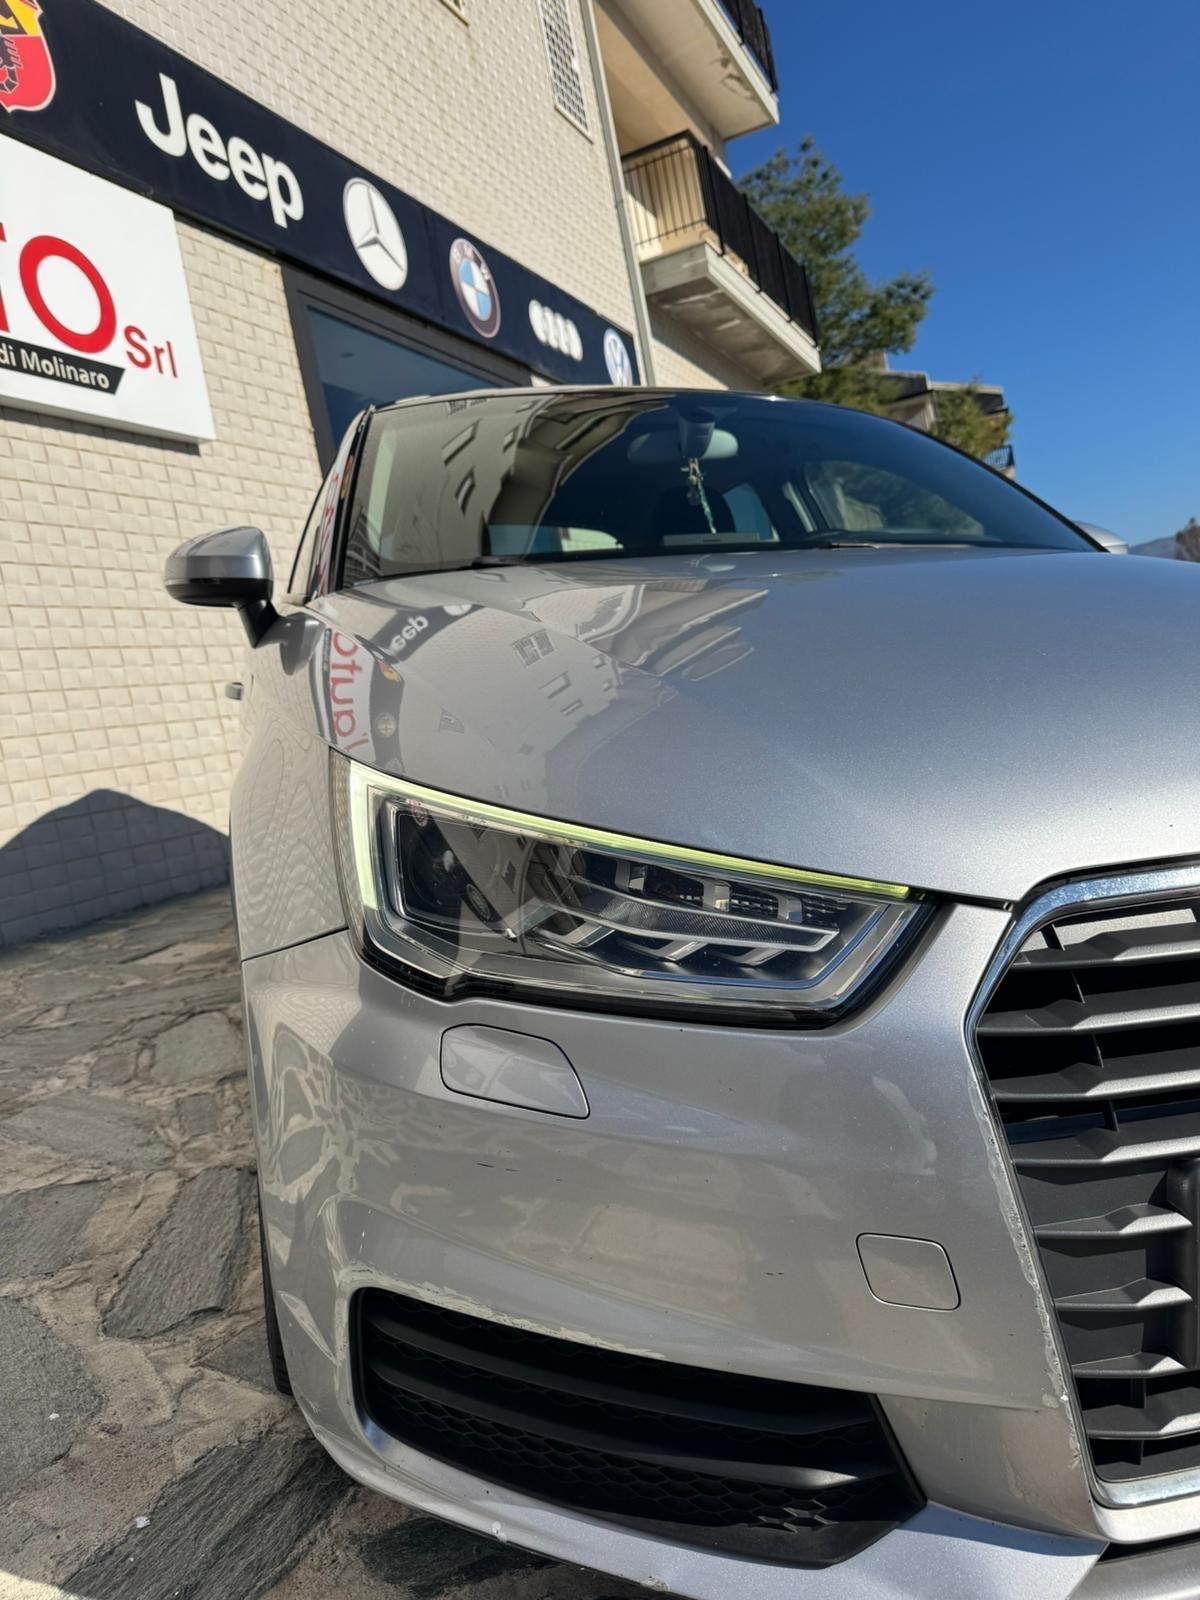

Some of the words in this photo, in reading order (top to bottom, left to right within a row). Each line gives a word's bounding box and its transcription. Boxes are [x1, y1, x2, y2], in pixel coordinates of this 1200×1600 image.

[134, 72, 304, 229] Jeep
[0, 222, 117, 354] O
[124, 325, 178, 379] Srl
[0, 342, 17, 367] di
[20, 347, 110, 389] Molinaro
